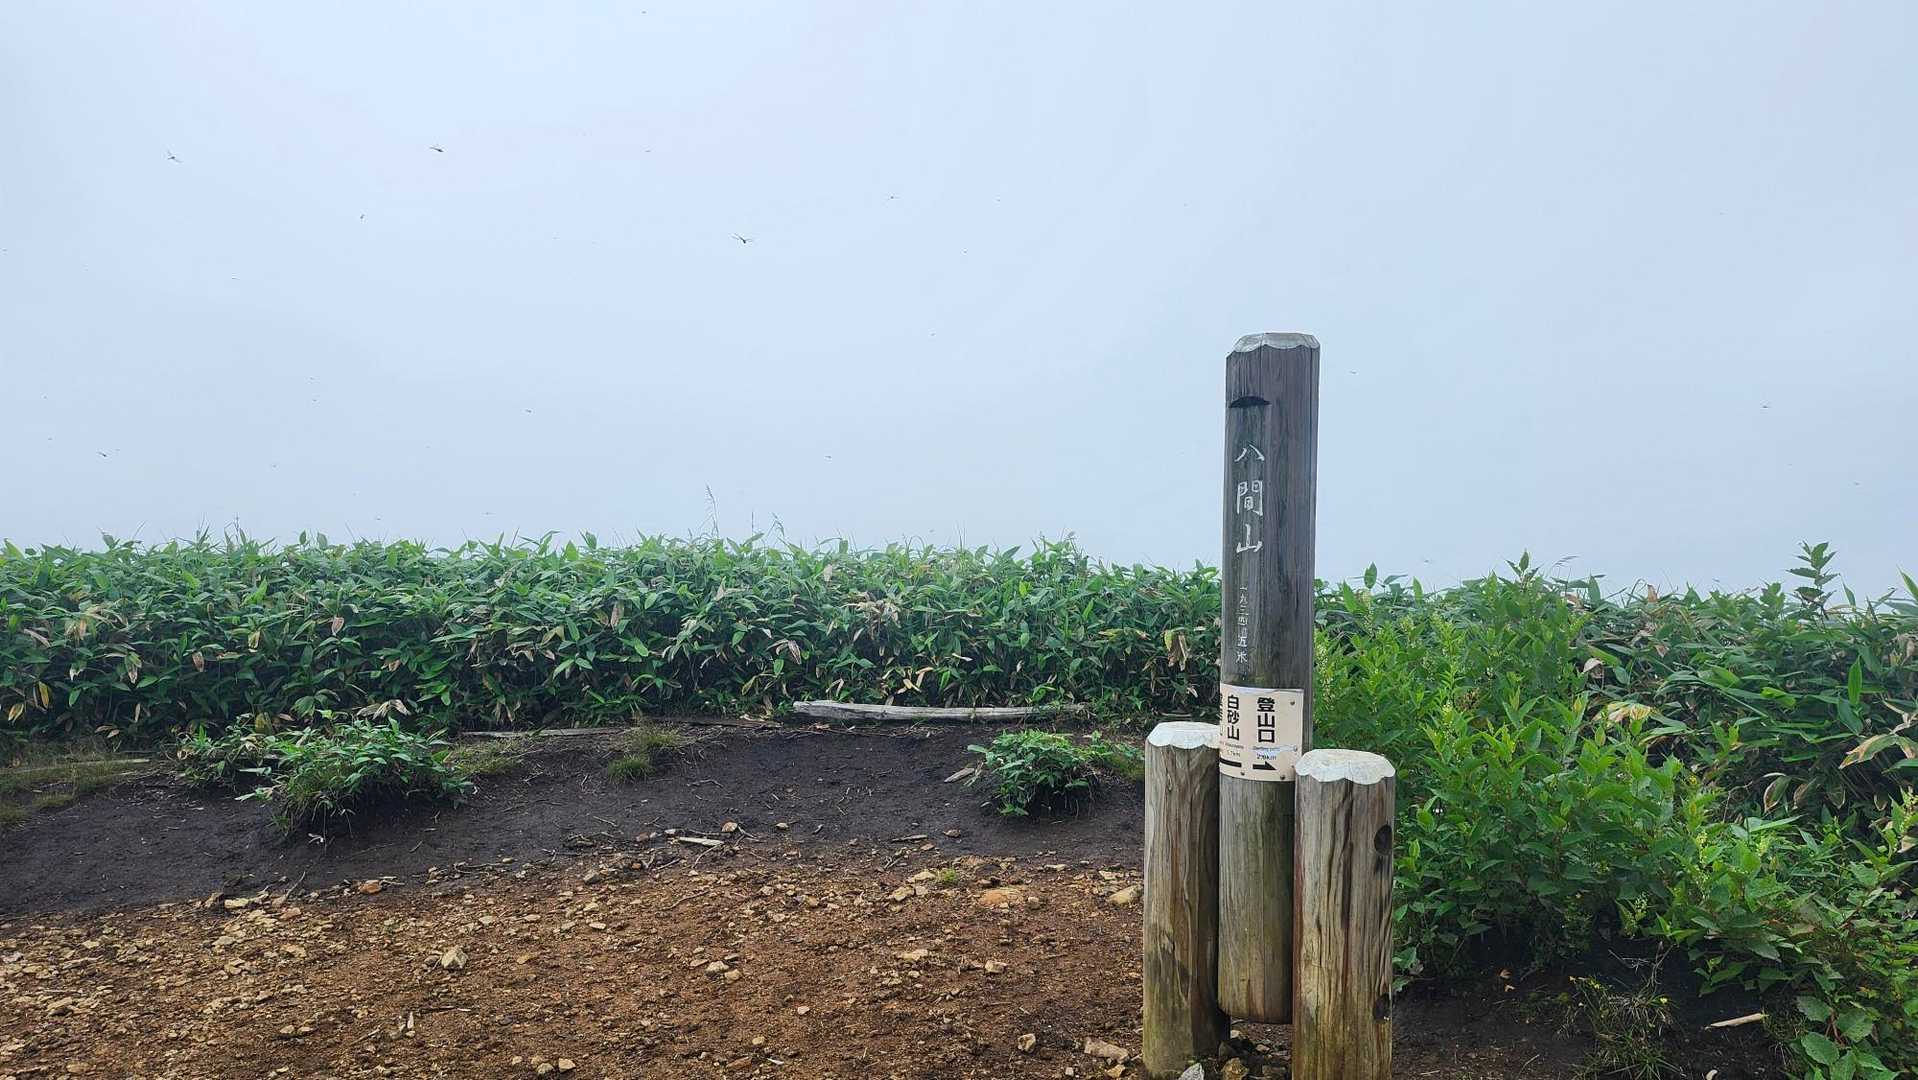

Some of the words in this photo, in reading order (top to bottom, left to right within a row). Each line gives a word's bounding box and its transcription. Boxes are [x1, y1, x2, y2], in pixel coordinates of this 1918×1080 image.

[1234, 443, 1265, 553] 八間山
[1227, 694, 1240, 741] 白砂山
[1257, 697, 1275, 744] 登山口
